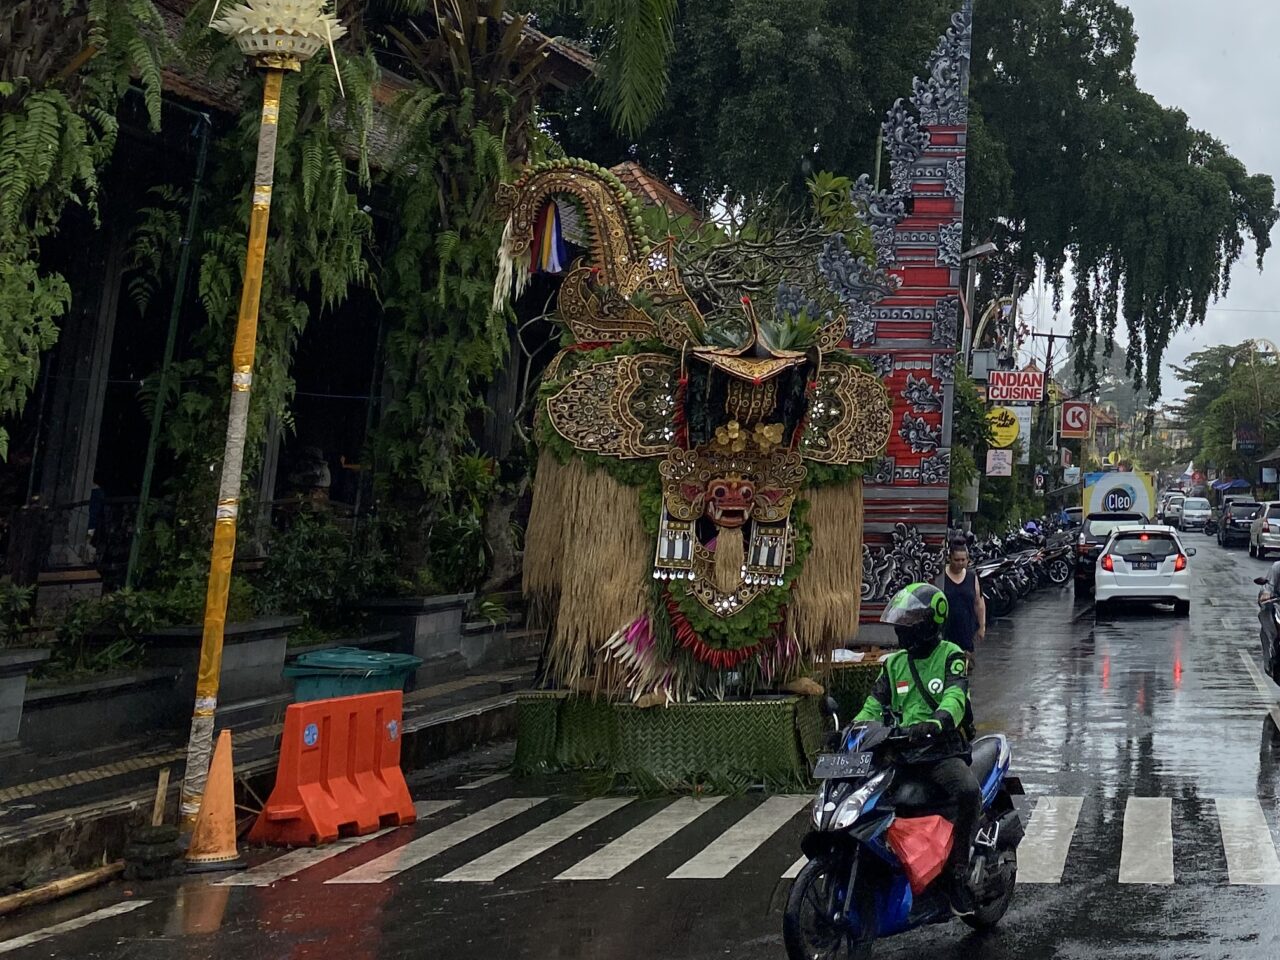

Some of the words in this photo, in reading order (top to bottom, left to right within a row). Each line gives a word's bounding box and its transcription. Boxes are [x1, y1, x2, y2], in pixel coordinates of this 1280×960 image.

[990, 372, 1042, 387] INDIAN
[990, 387, 1042, 400] CUISINE
[1108, 493, 1130, 509] Cleo
